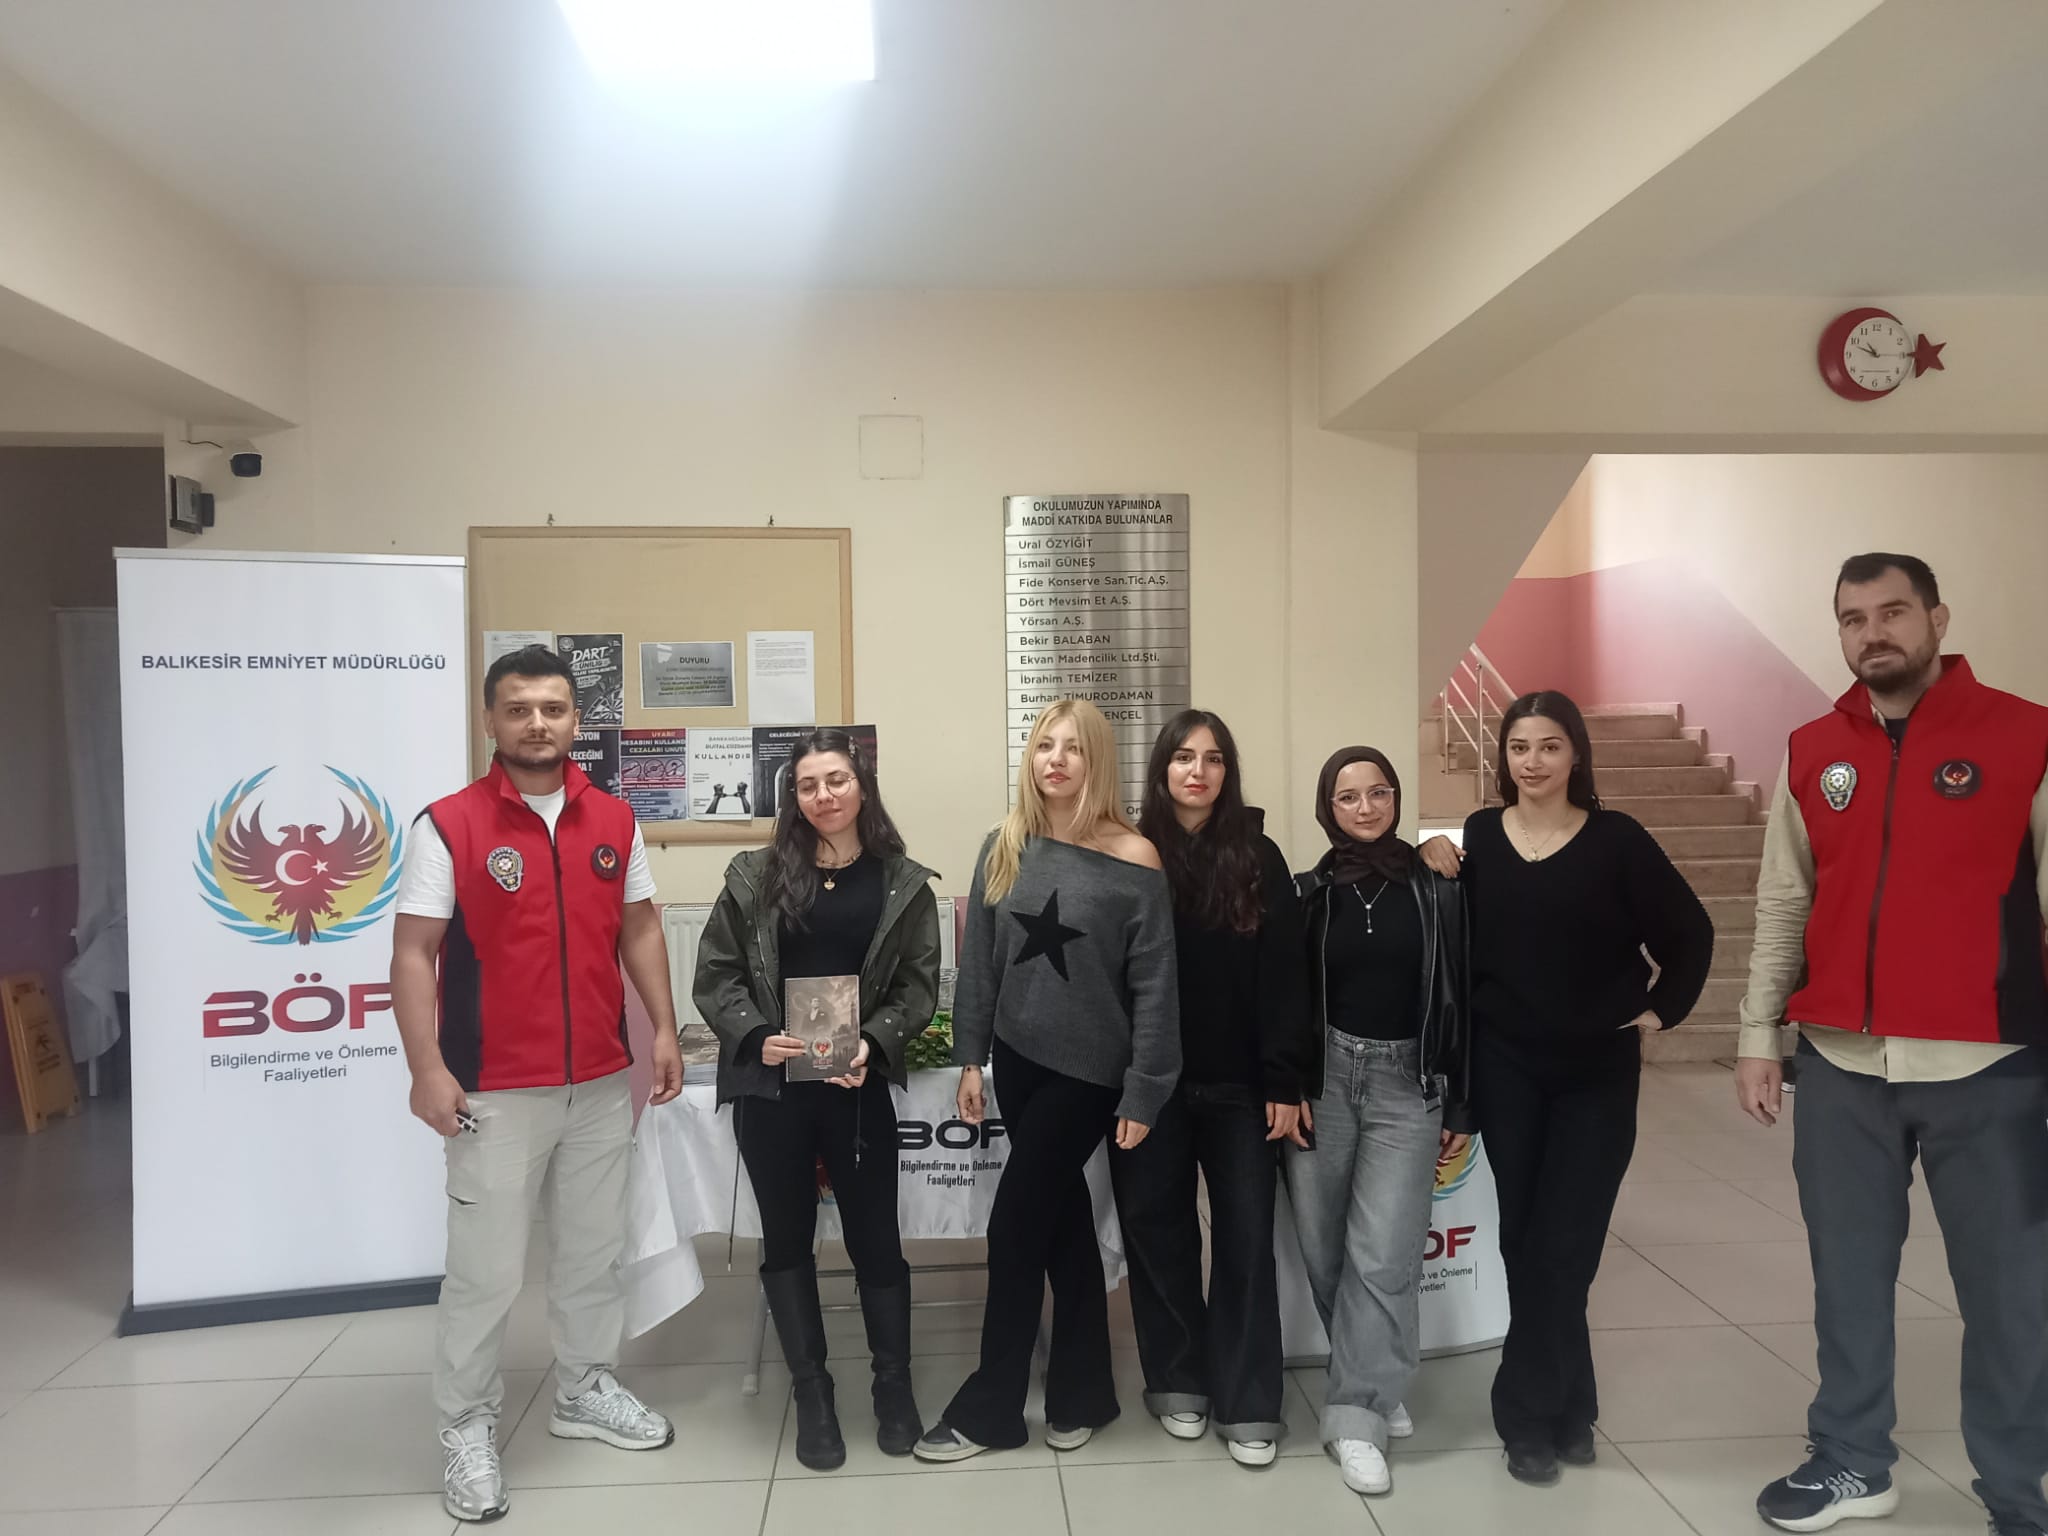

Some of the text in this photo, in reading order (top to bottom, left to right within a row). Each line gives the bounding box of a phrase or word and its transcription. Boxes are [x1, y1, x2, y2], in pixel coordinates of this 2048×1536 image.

[1033, 500, 1162, 511] OKULUMUZUN YAPIMINDA
[1022, 514, 1173, 526] MADDİ KATKIDA BULUNANLAR
[1019, 537, 1093, 549] Ural ÖZYİĞİT
[1019, 556, 1096, 568] İsmail GÜNEŞ
[1019, 578, 1043, 587] Fide
[1049, 577, 1100, 587] Konserve
[1019, 598, 1044, 607] Dört
[1049, 597, 1090, 606] Mevsim
[1110, 596, 1131, 605] A.Ş.
[1020, 616, 1084, 626] Yörsan A.Ş.
[1020, 635, 1110, 646] Bekir BALABAN
[569, 646, 609, 664] DART
[680, 656, 710, 664] DUYURU
[1020, 653, 1159, 664] Ekvan Madencilik Ltd.Şti.
[142, 653, 446, 670] BALIKESİR EMNİYET MÜDÜRLÜĞÜ
[1020, 672, 1117, 684] İbrahim TEMİZER
[1021, 694, 1060, 703] Burhan
[1105, 711, 1142, 721] ENÇEL
[203, 972, 393, 1038] BÖF
[210, 1044, 397, 1070] Bilgilendirme ve Önleme
[264, 1065, 347, 1082] Faaliyetleri
[900, 1160, 956, 1174] Bilgilendirme
[973, 1159, 1002, 1171] Önleme
[927, 1174, 975, 1188] Faaliyetleri
[1441, 1268, 1472, 1277] Önleme
